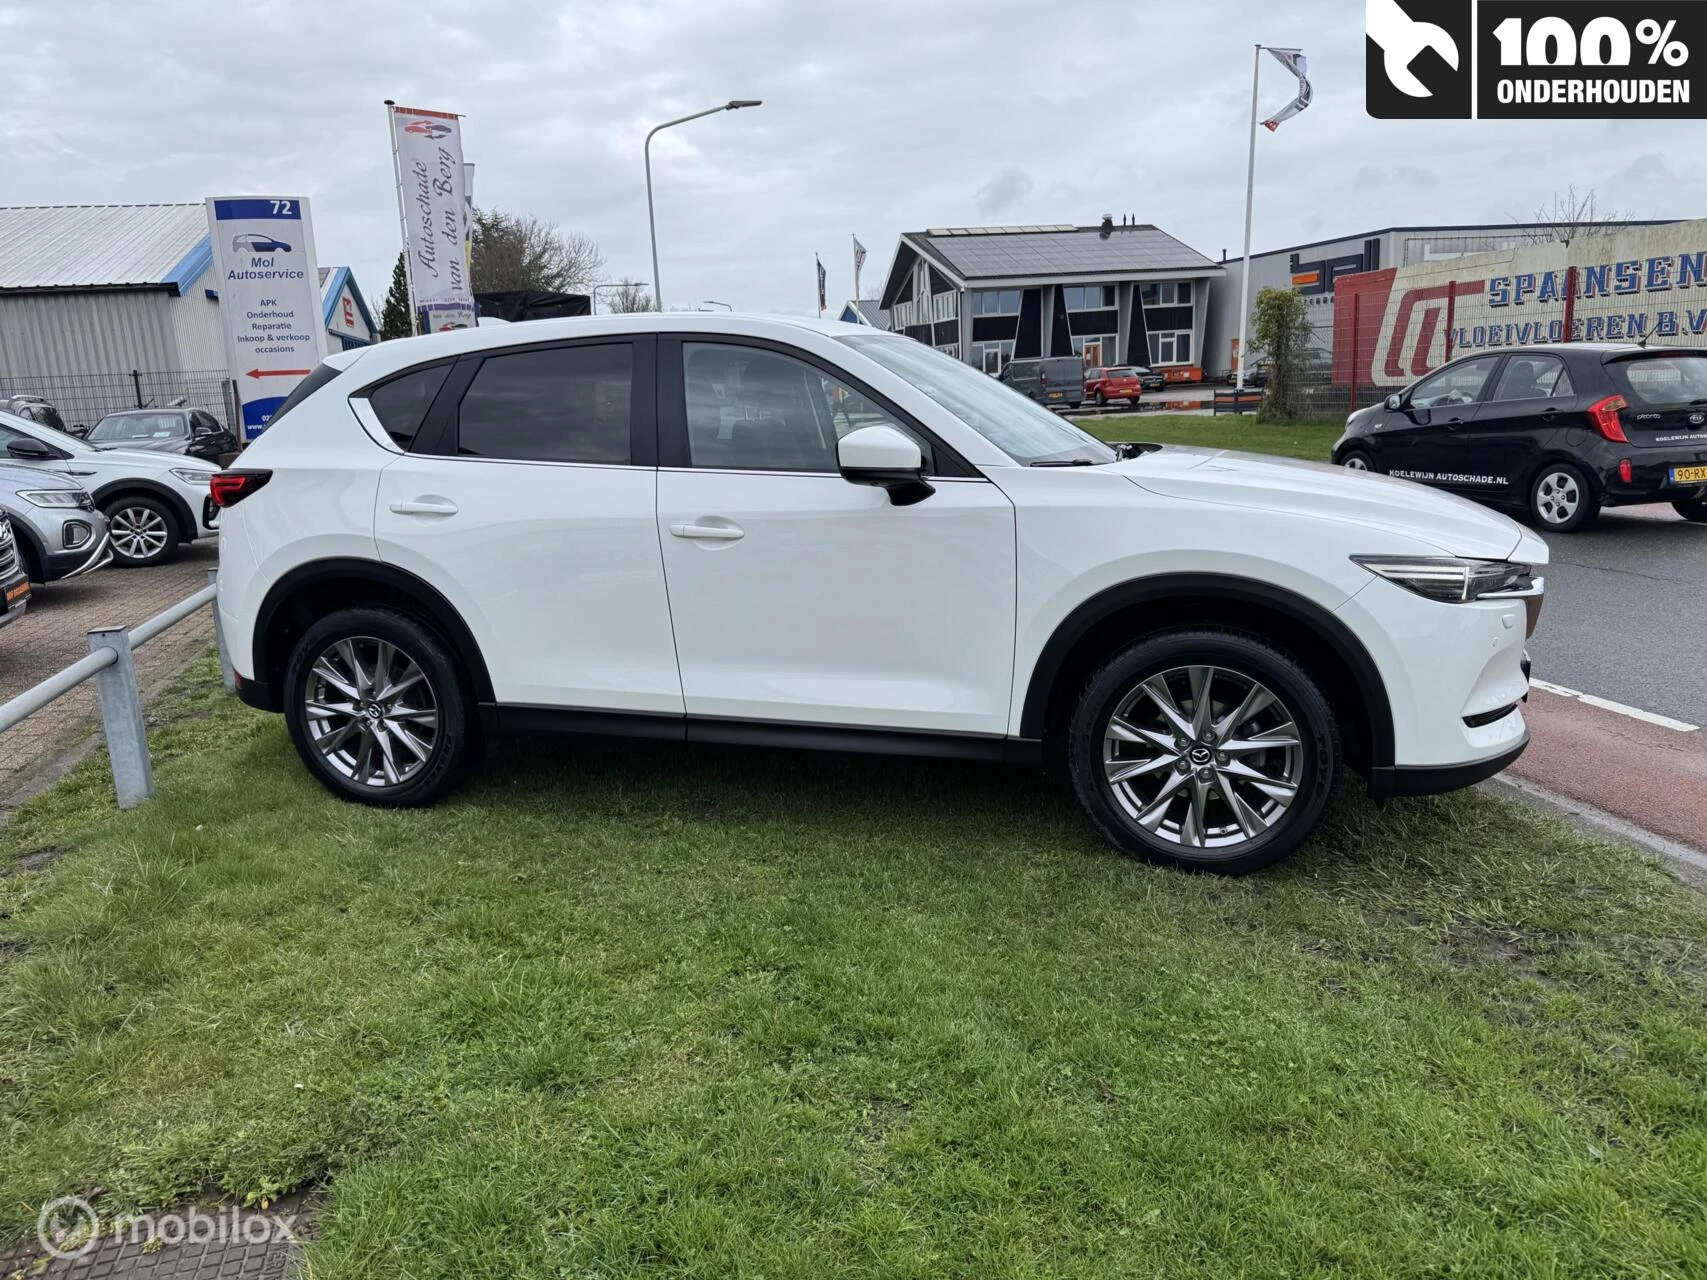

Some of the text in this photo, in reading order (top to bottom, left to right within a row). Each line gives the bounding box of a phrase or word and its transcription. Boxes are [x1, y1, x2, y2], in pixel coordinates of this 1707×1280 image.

[270, 200, 292, 214] 72
[412, 160, 438, 278] Autoschade
[432, 147, 463, 291] van den Berg
[251, 257, 274, 268] Mol
[228, 269, 304, 280] Autoservice
[260, 299, 277, 307] APK
[246, 310, 294, 319] Onderhoud
[252, 322, 292, 331] Reparatie
[237, 335, 265, 343] Inkoop
[276, 334, 310, 342] verkoop
[255, 345, 294, 354] occasions
[1389, 470, 1509, 485] KOELEWIJN AUTOSCHADE.NL
